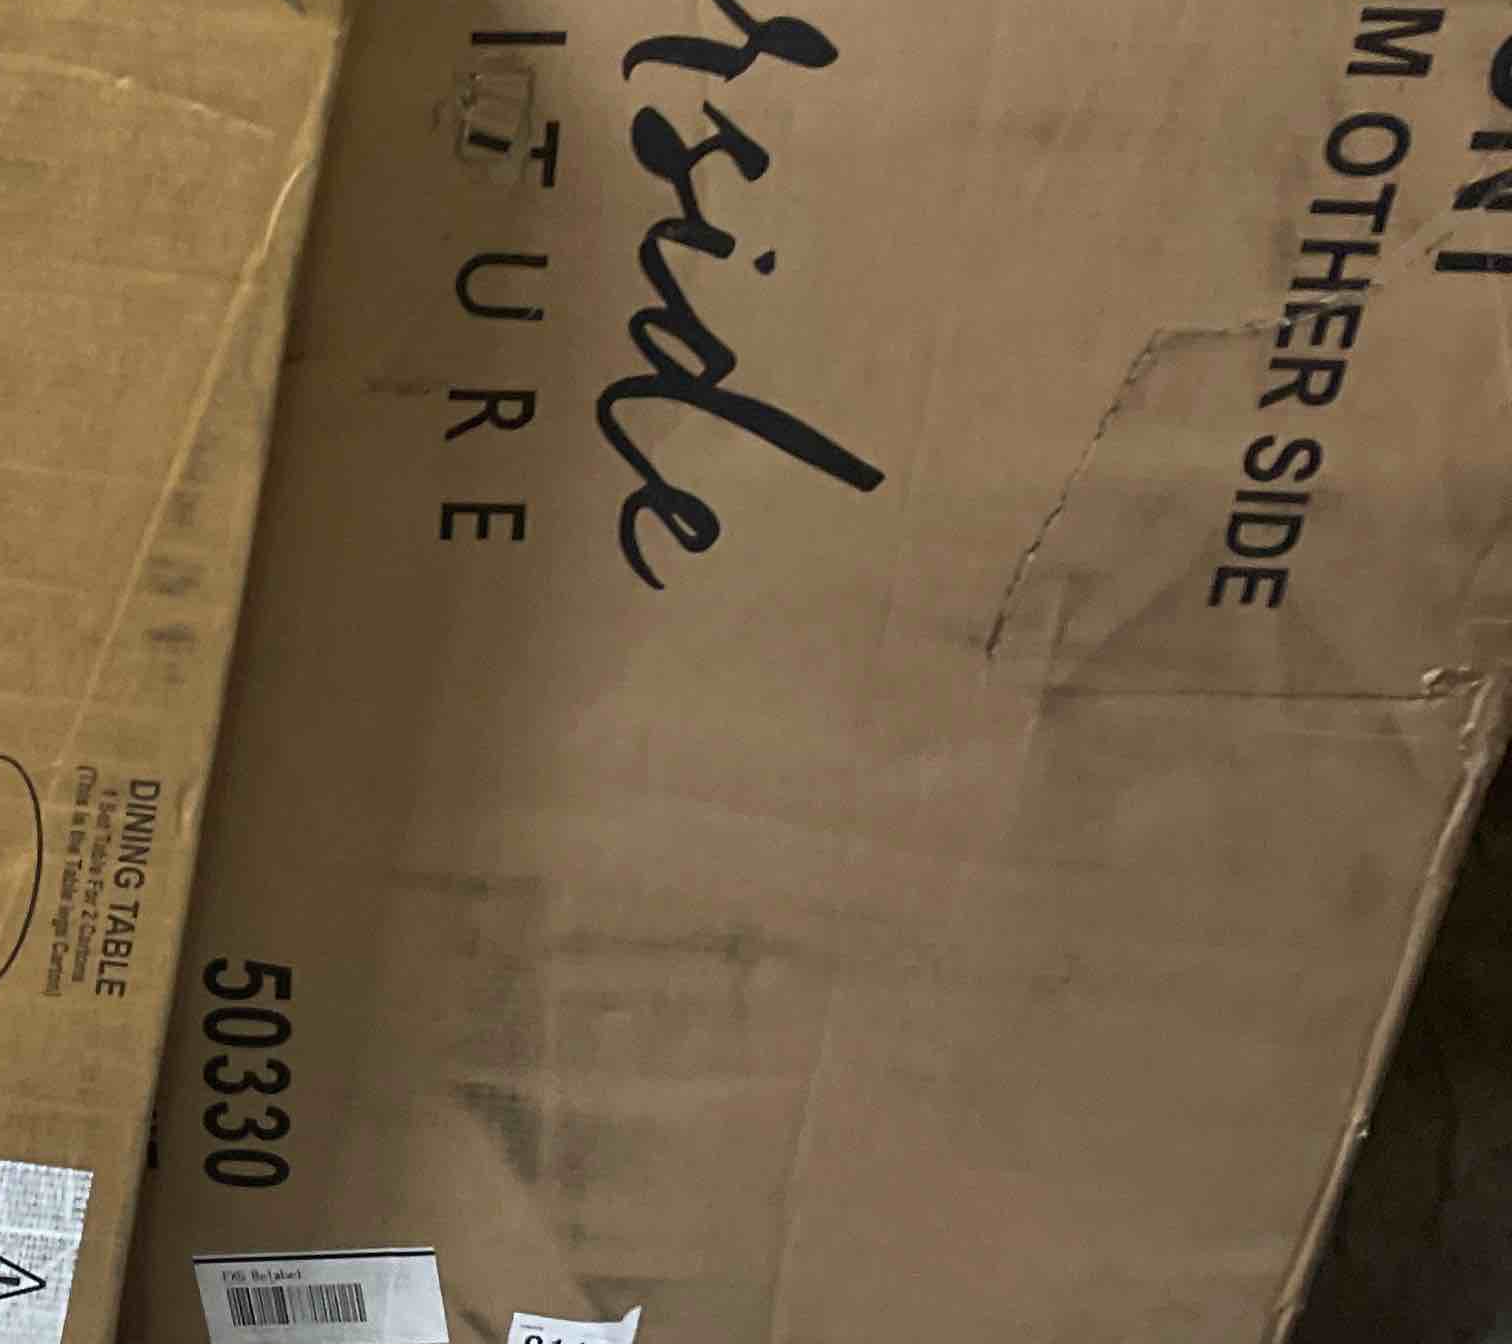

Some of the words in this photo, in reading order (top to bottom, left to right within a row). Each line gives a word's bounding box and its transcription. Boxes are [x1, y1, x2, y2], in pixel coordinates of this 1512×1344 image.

[1258, 113, 1411, 409] OTHER
[1207, 435, 1322, 609] SIDE
[113, 778, 162, 891] DINING
[81, 909, 99, 923] 2
[85, 879, 104, 906] For
[94, 900, 141, 999] TABLE
[201, 957, 293, 1189] 50330
